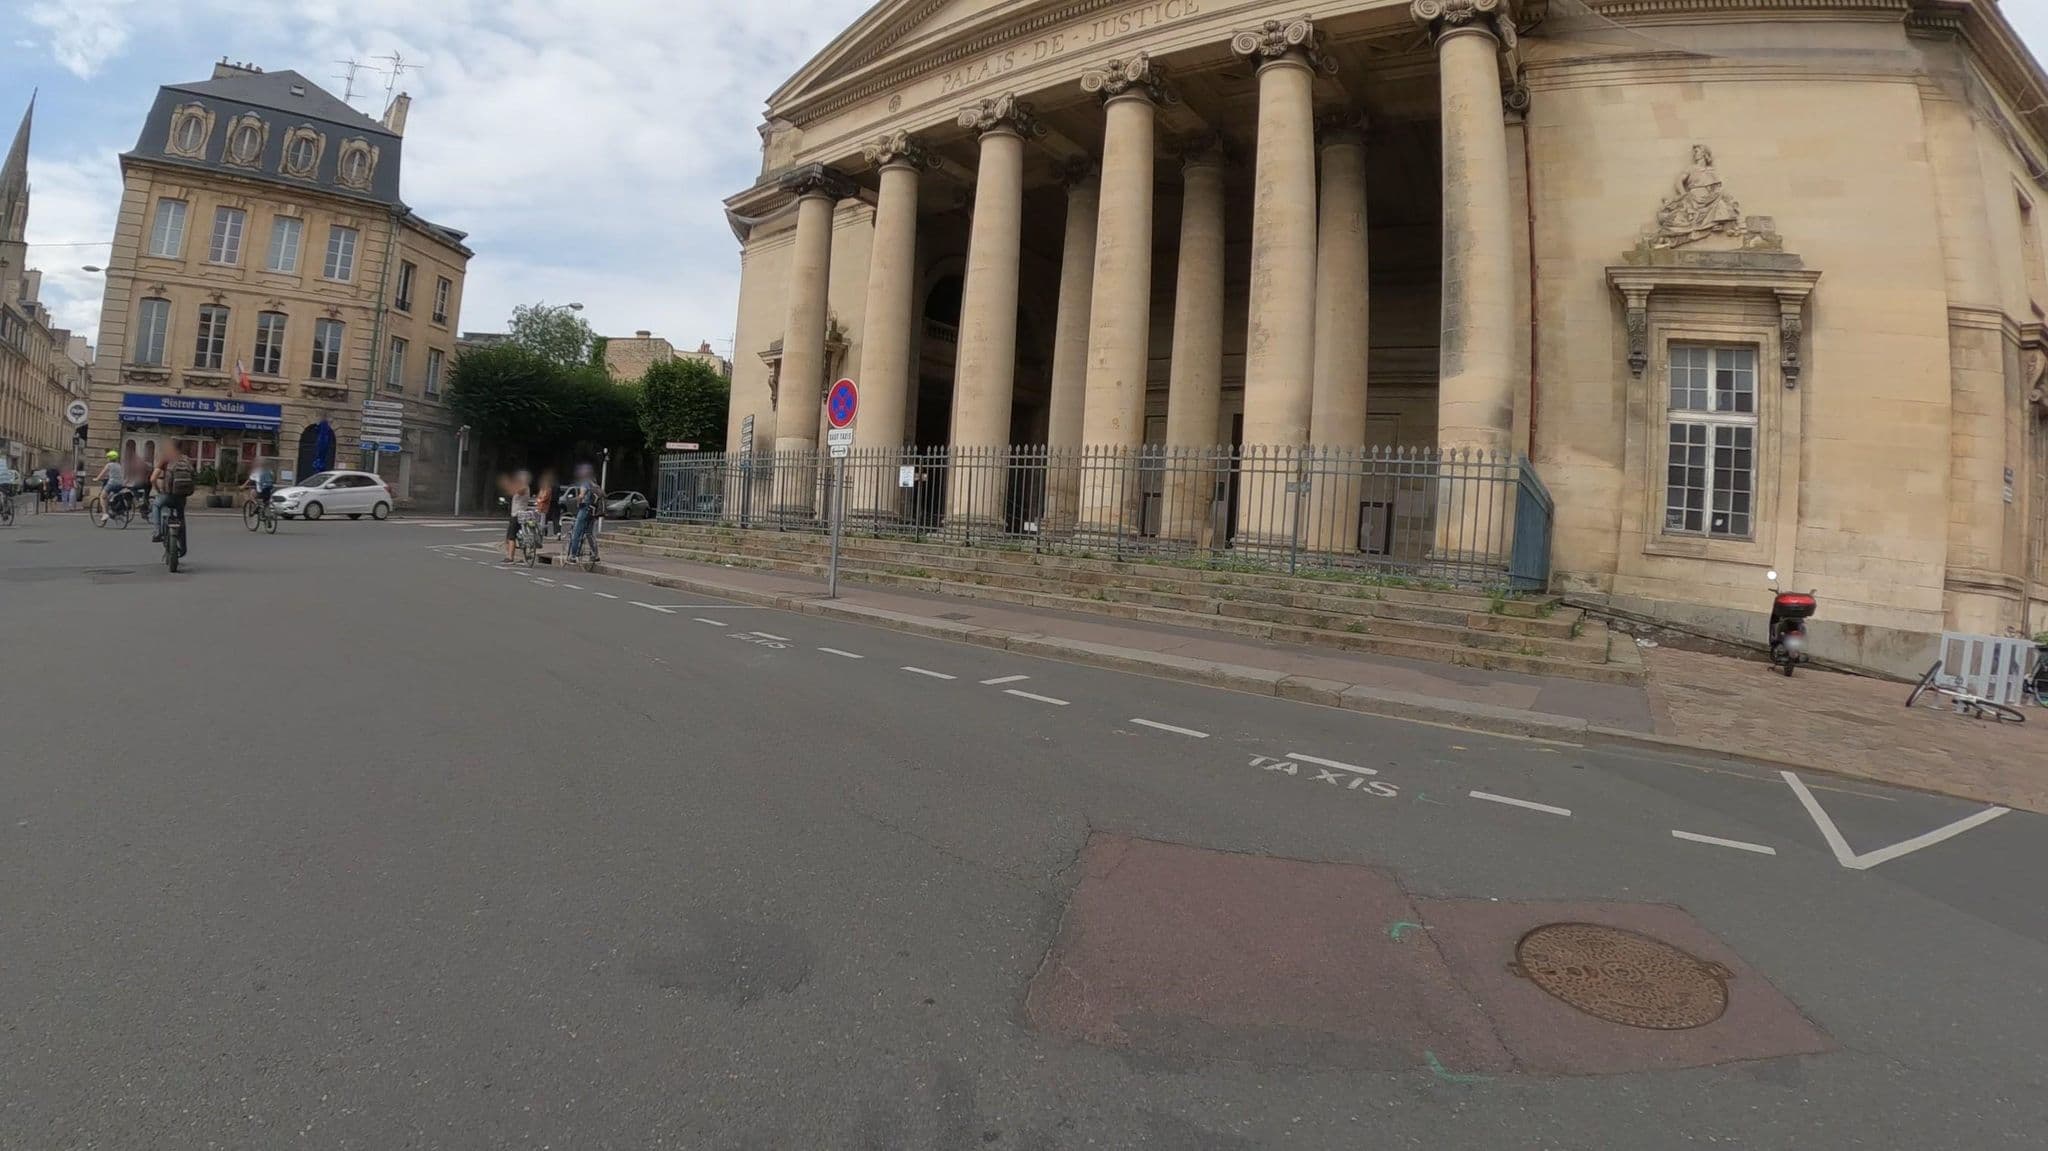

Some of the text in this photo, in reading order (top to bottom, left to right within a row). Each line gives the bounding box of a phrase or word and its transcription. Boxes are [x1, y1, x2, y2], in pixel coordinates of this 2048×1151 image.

[940, 0, 1200, 93] PALAIS DE JUSTICE
[161, 397, 196, 409] Bistrot
[214, 400, 245, 413] Palais
[1249, 753, 1400, 797] TAXIS
